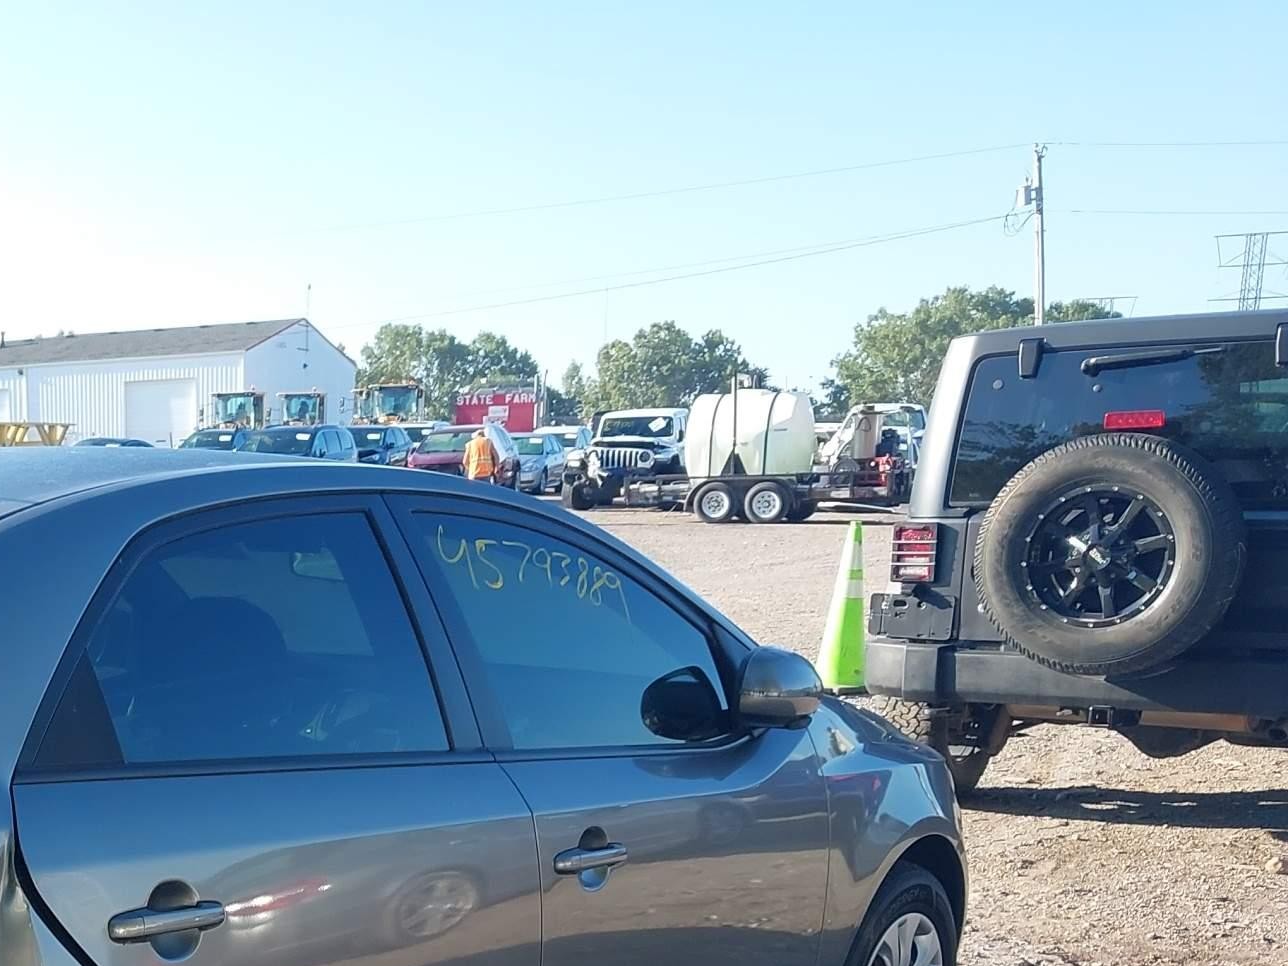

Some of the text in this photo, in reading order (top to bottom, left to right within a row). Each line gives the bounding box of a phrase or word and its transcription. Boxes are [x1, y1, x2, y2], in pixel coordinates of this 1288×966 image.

[456, 392, 536, 406] STATE FARM
[436, 523, 632, 625] 45793889
